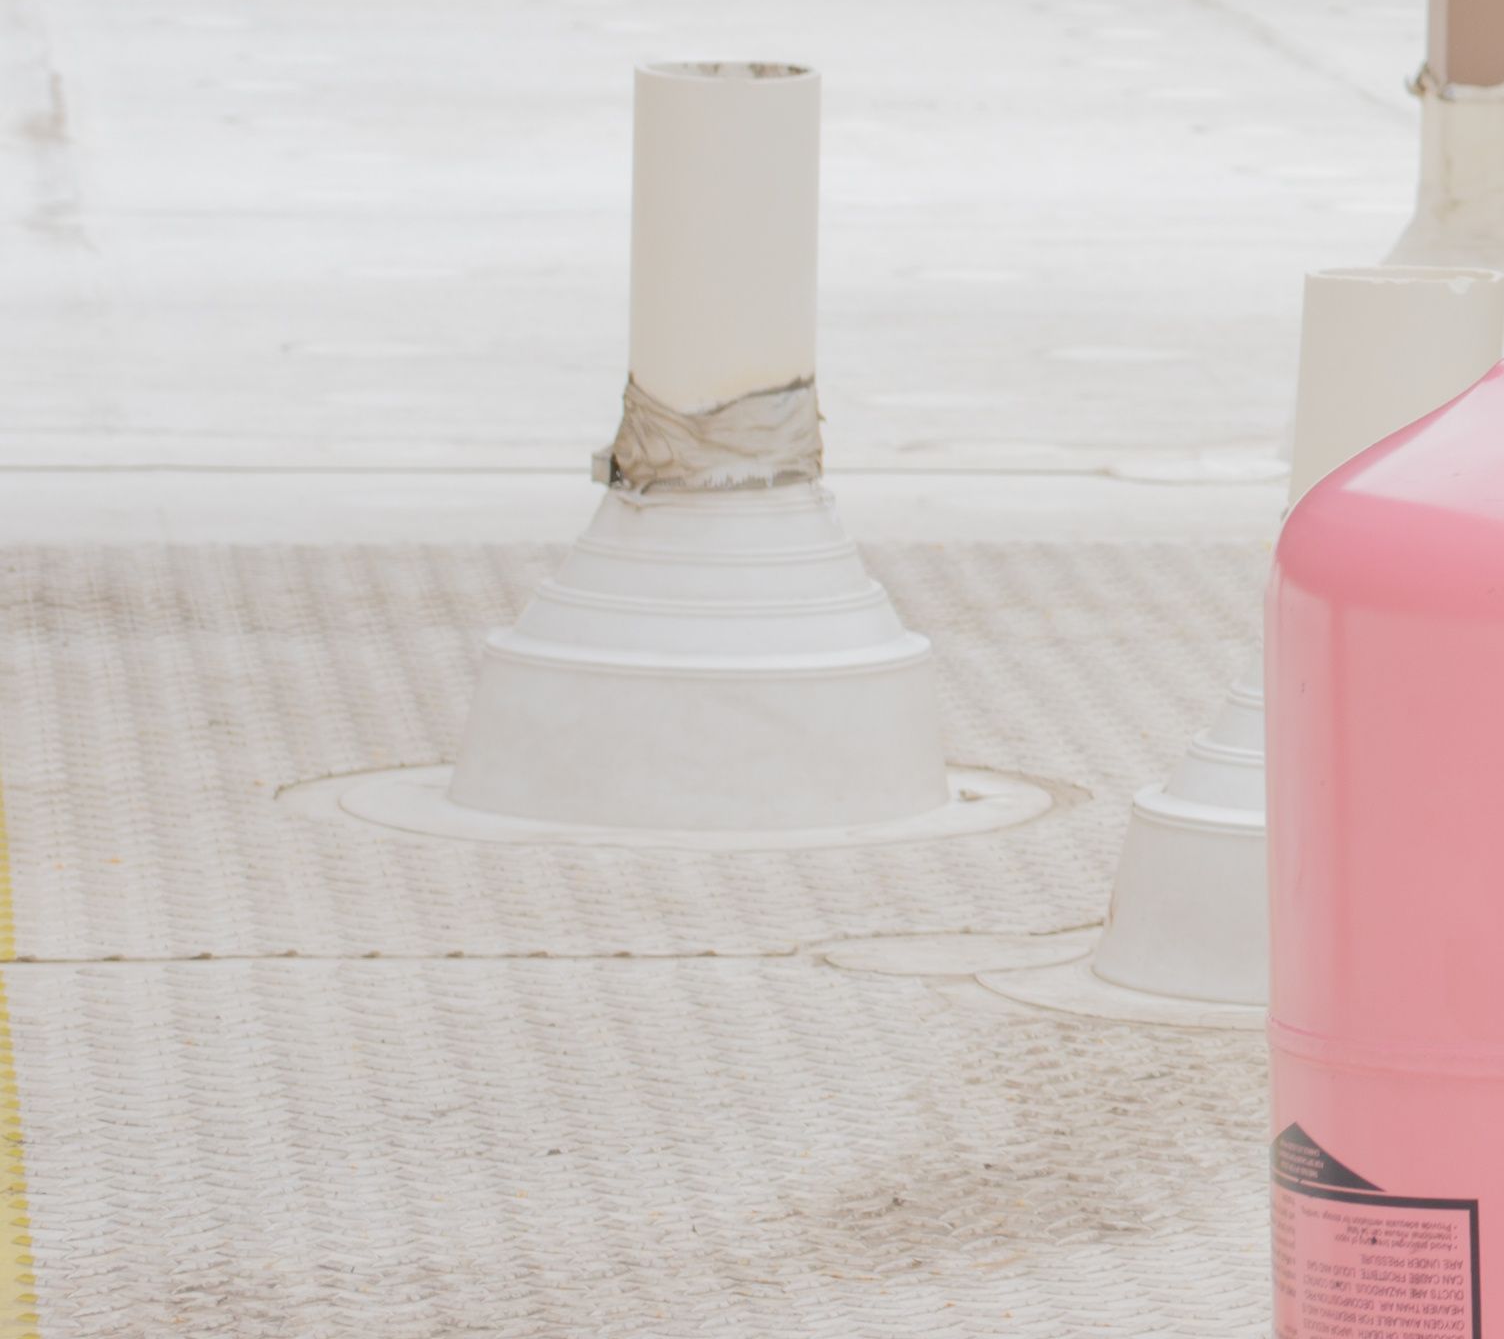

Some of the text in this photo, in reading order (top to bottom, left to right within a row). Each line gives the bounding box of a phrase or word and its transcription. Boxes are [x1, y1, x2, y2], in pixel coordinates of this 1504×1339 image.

[1407, 1258, 1440, 1269] UNDER
[1442, 1260, 1463, 1270] ARE
[1442, 1275, 1464, 1285] CAN
[1409, 1289, 1428, 1299] ARE
[1430, 1289, 1464, 1300] DUCTS
[1396, 1303, 1420, 1314] THAN
[1423, 1305, 1464, 1315] HEAVIER
[1377, 1316, 1421, 1329] AVAILABLE
[1423, 1319, 1465, 1331] OXYGEN
